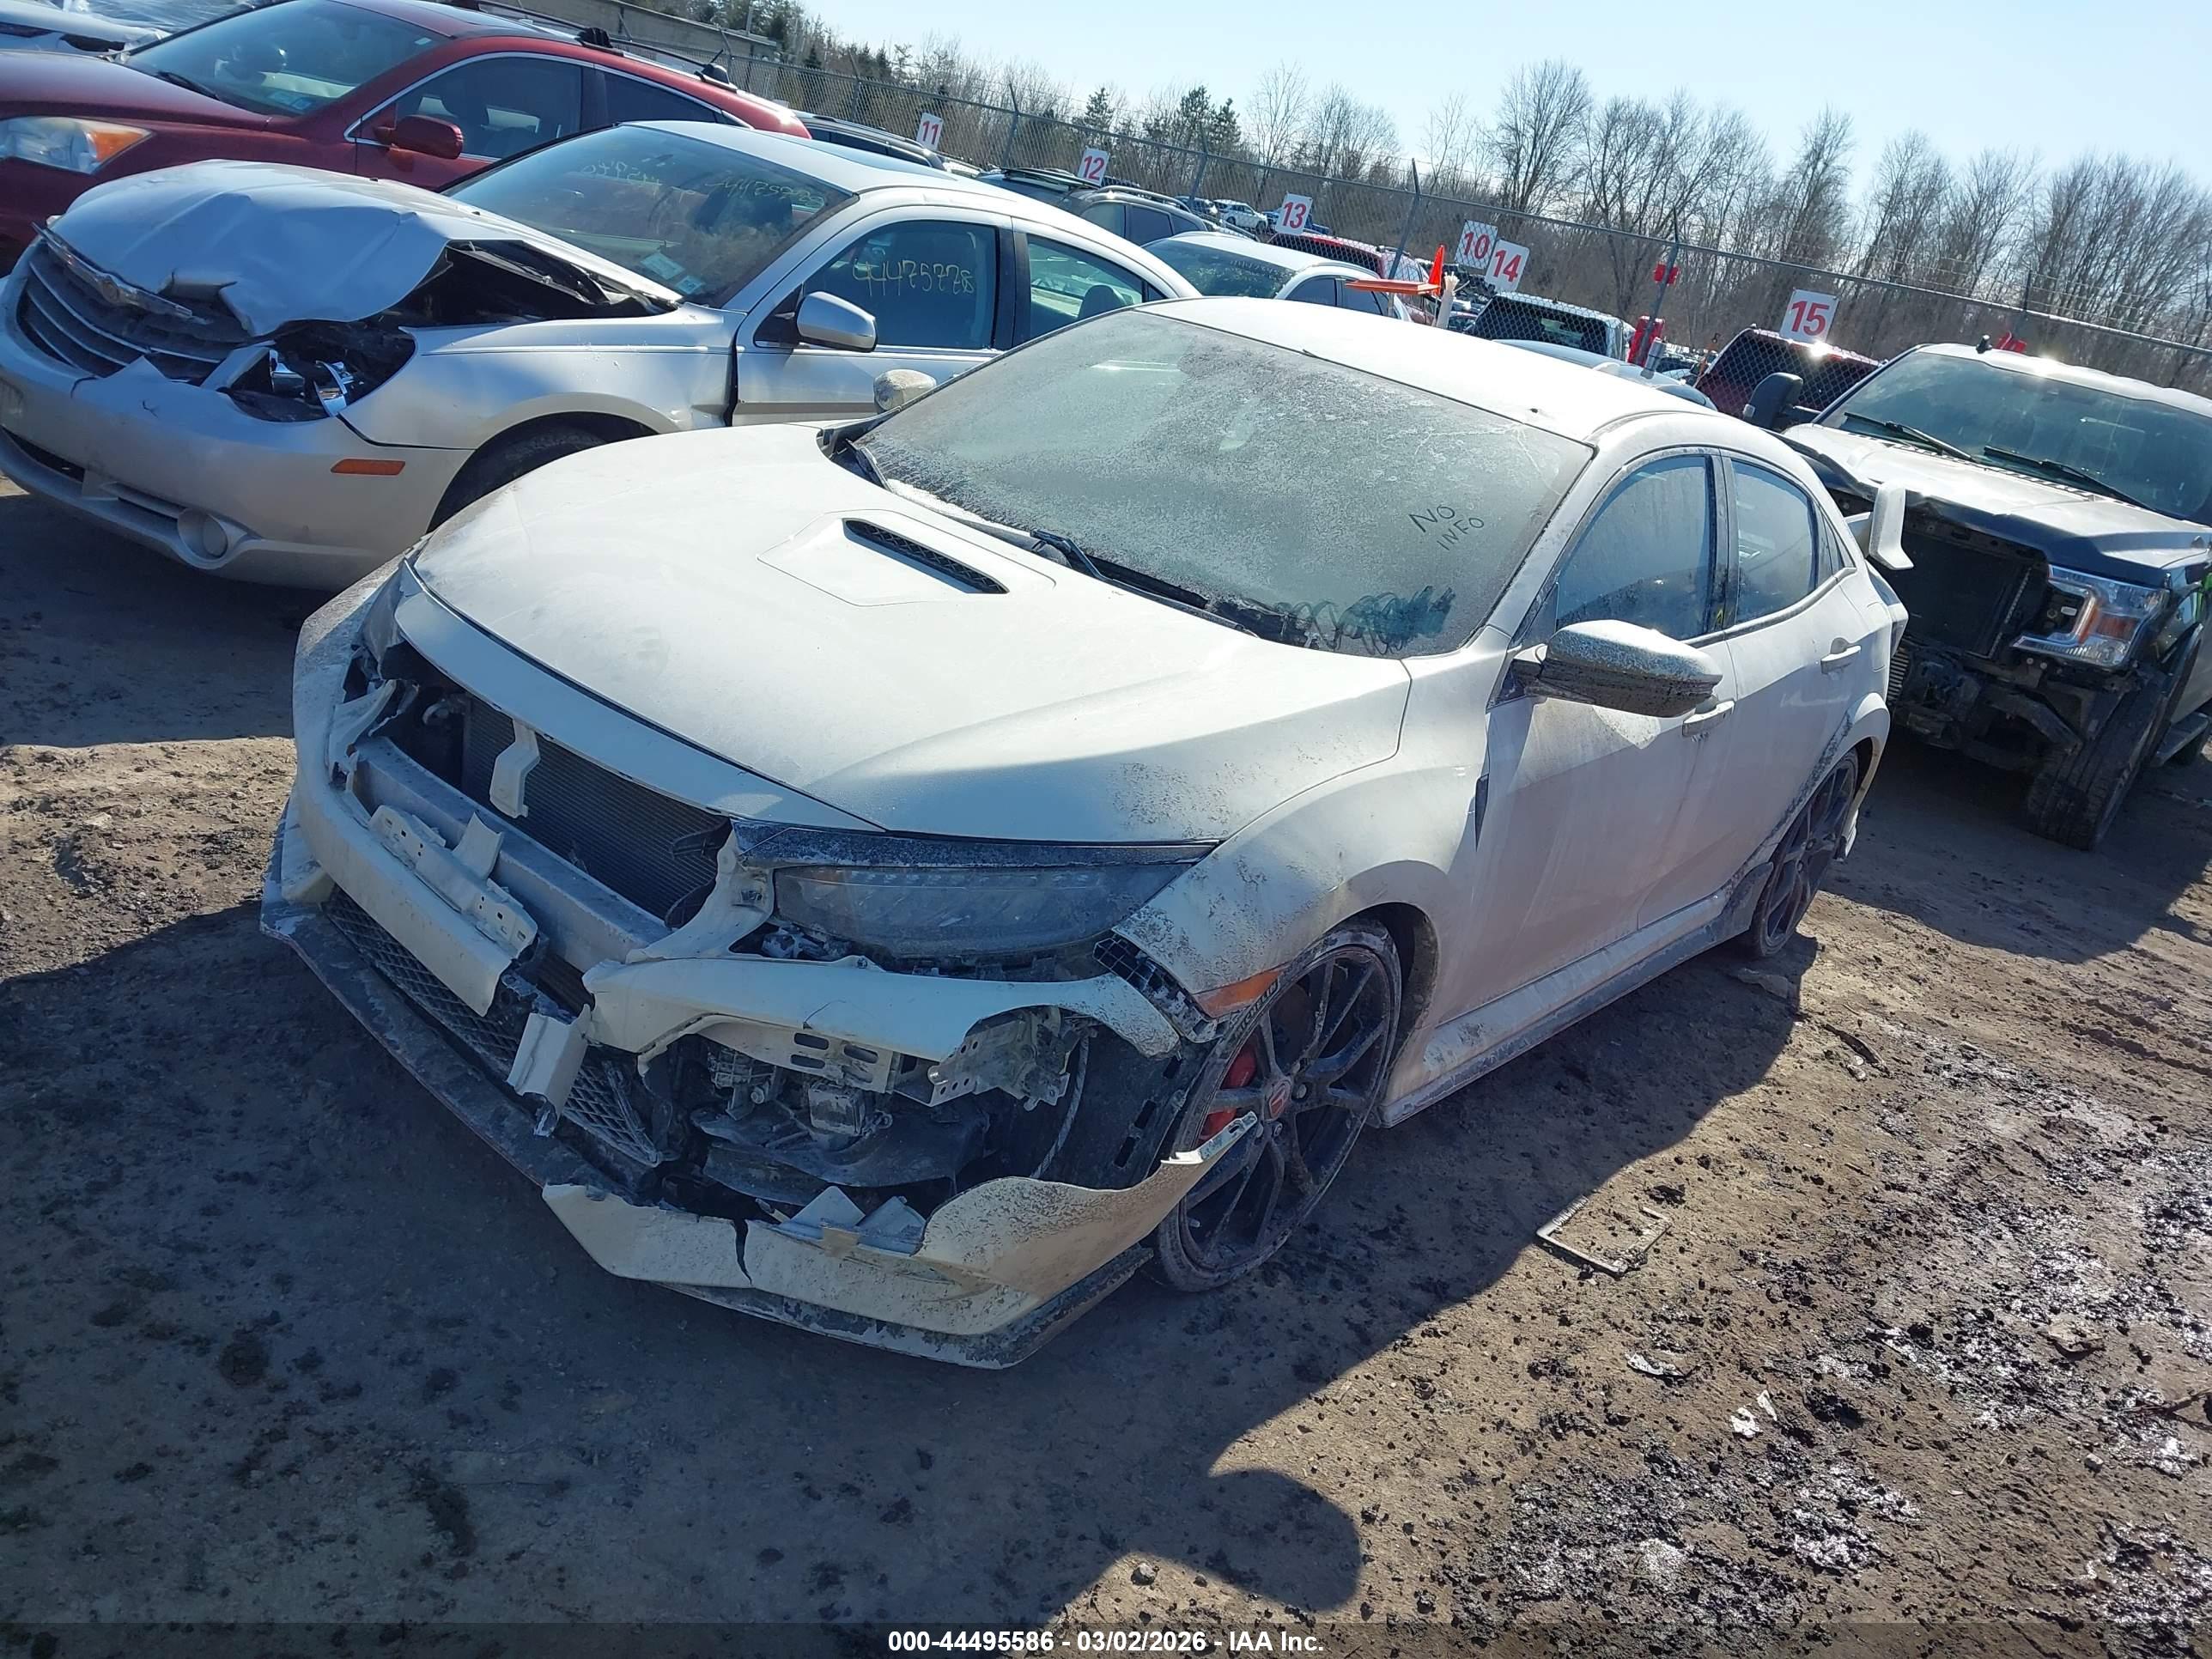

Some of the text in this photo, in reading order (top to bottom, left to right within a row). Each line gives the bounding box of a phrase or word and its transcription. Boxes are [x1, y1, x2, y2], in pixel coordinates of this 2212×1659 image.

[922, 120, 939, 145] 11
[1083, 155, 1105, 181] 12
[1282, 202, 1307, 228] 13
[1463, 231, 1491, 260] 10
[1493, 249, 1522, 283] 14
[1791, 300, 1830, 336] 15
[1408, 504, 1455, 532] NO
[1437, 517, 1485, 551] INFO
